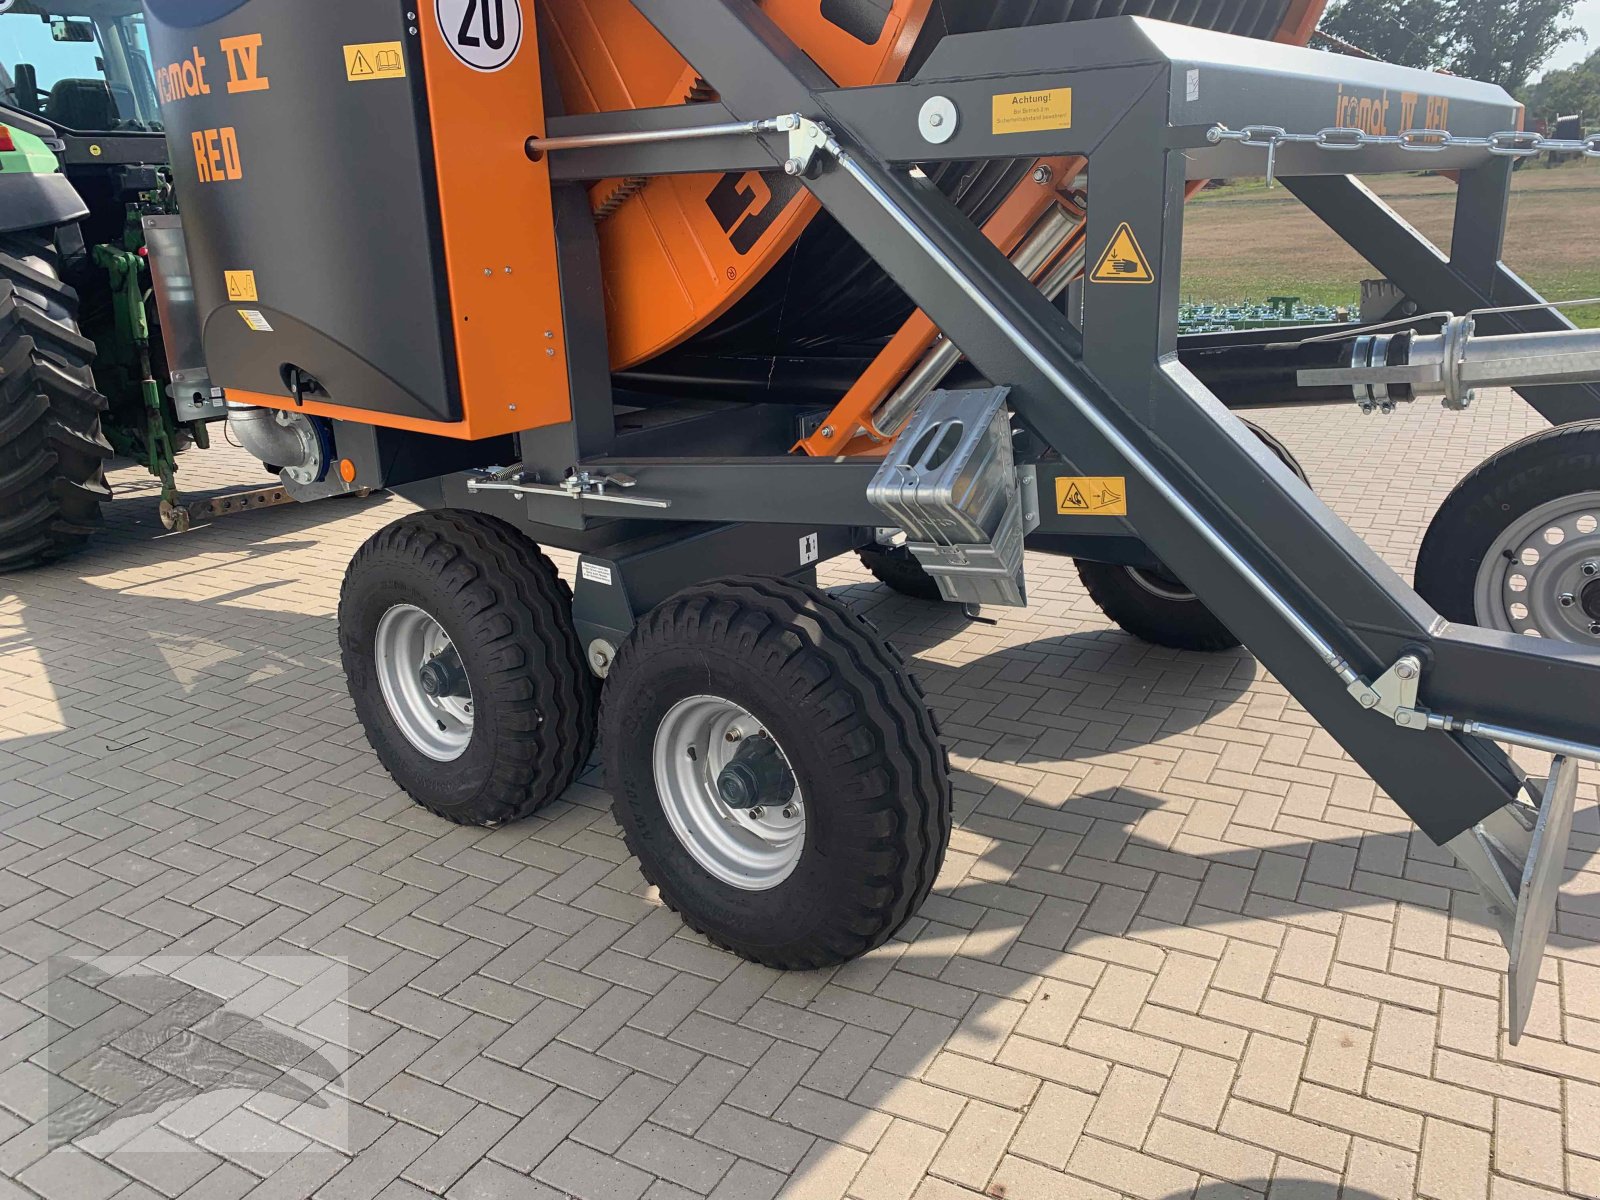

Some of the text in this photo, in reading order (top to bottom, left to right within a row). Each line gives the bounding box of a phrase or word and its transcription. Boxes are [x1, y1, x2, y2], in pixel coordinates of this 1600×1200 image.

[457, 0, 505, 50] 20
[219, 33, 270, 94] IV
[1011, 93, 1052, 105] Achtung!
[1336, 83, 1389, 136] iromat
[191, 126, 243, 183] RED
